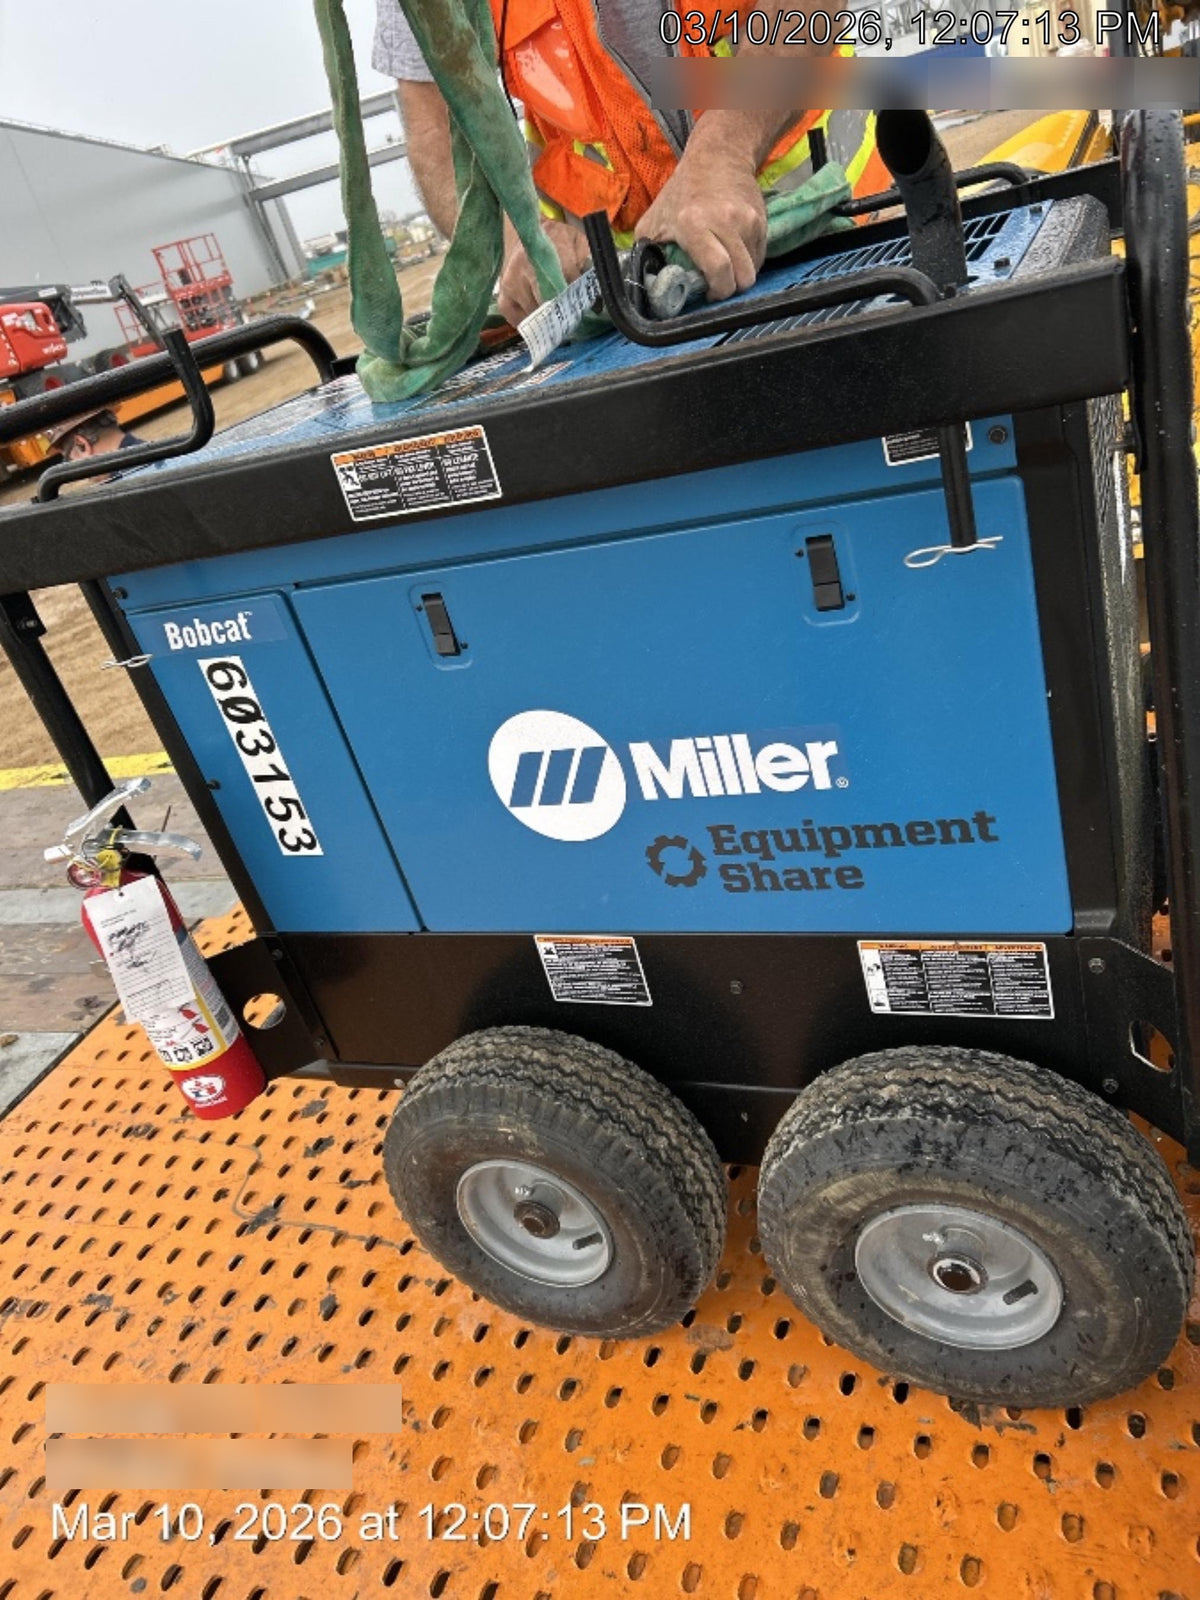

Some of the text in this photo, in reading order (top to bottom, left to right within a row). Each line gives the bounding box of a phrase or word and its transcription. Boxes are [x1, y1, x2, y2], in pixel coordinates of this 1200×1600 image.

[206, 661, 318, 853] 603153
[706, 810, 999, 862] Equipment
[718, 862, 865, 893] Share
